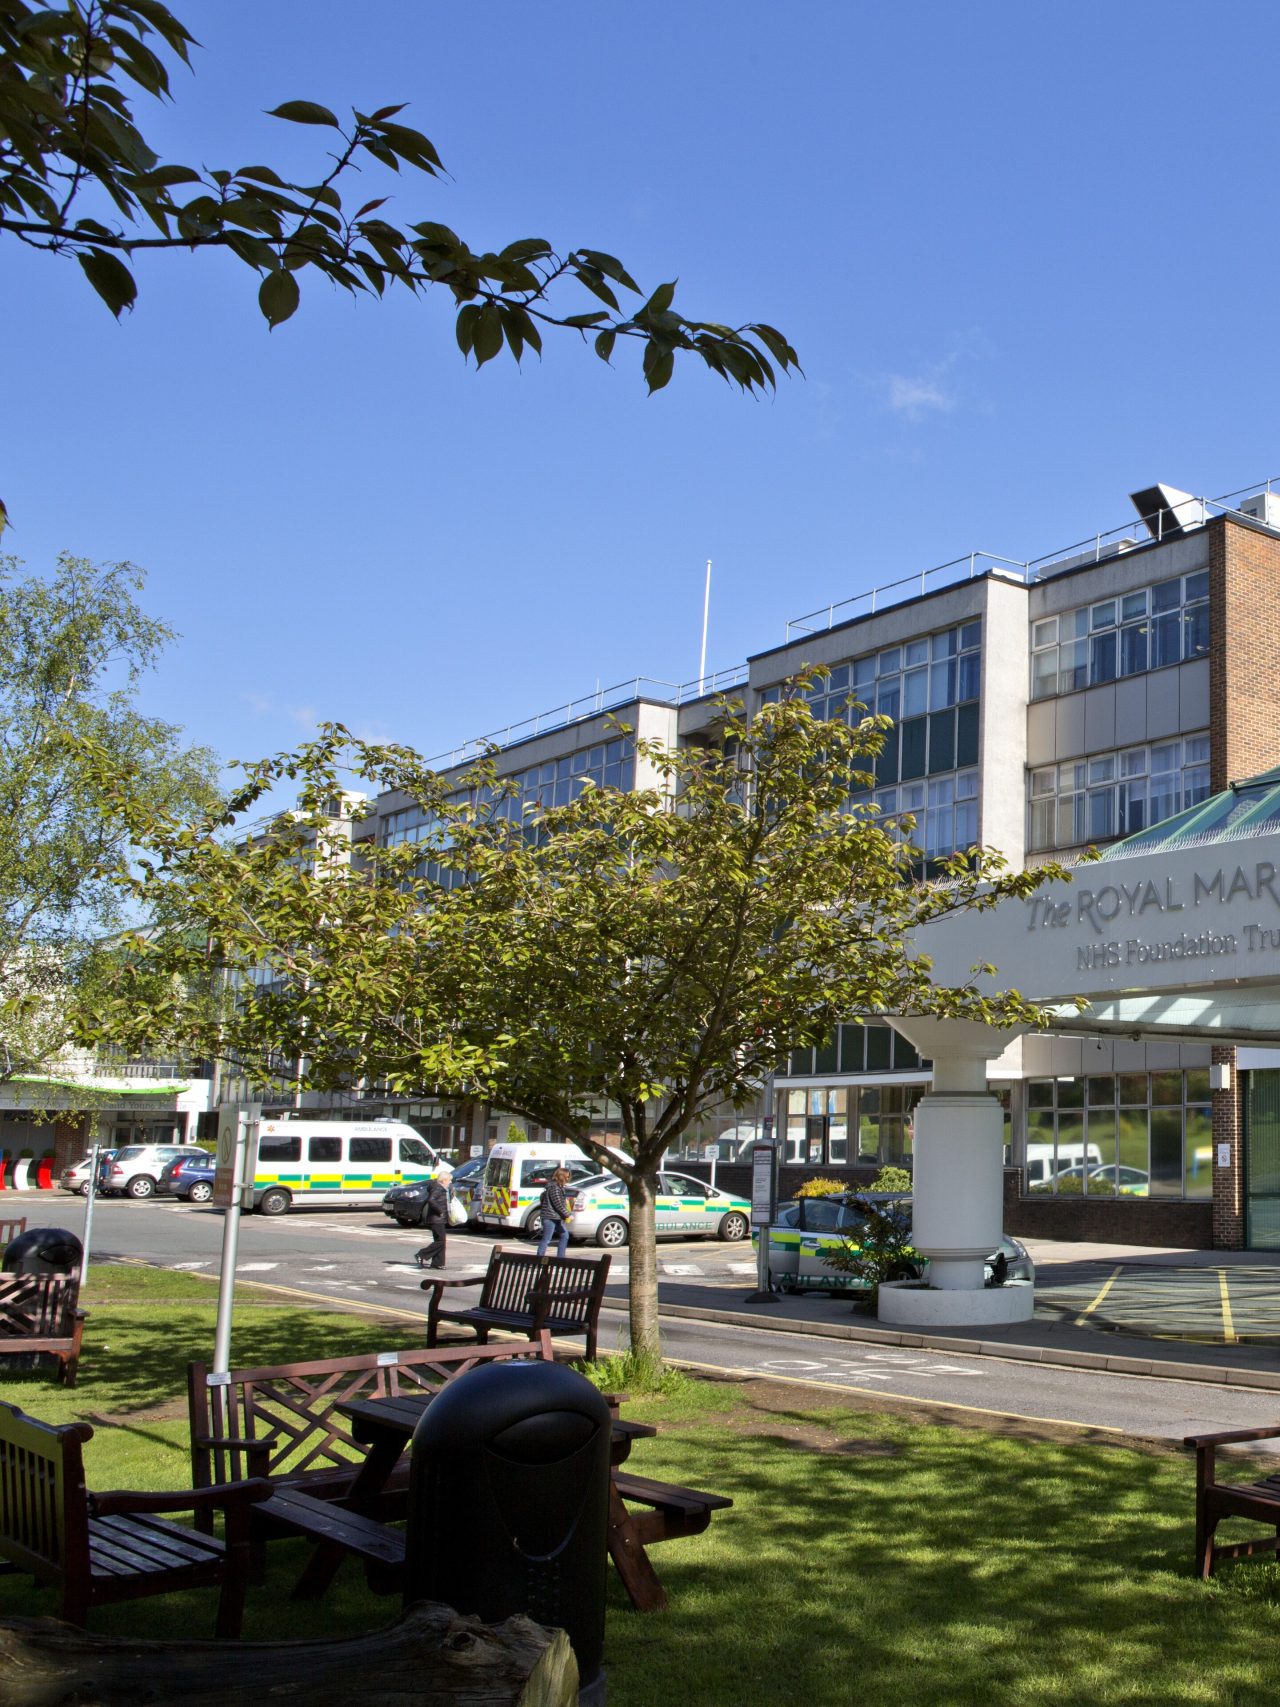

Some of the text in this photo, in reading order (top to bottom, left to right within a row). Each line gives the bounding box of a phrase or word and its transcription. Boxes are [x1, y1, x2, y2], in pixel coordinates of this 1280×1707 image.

[1025, 893, 1072, 931] The
[1076, 876, 1186, 934] ROYAL
[1076, 943, 1122, 971] NHS
[1125, 929, 1239, 965] Foundation
[655, 1221, 713, 1231] BULANCE
